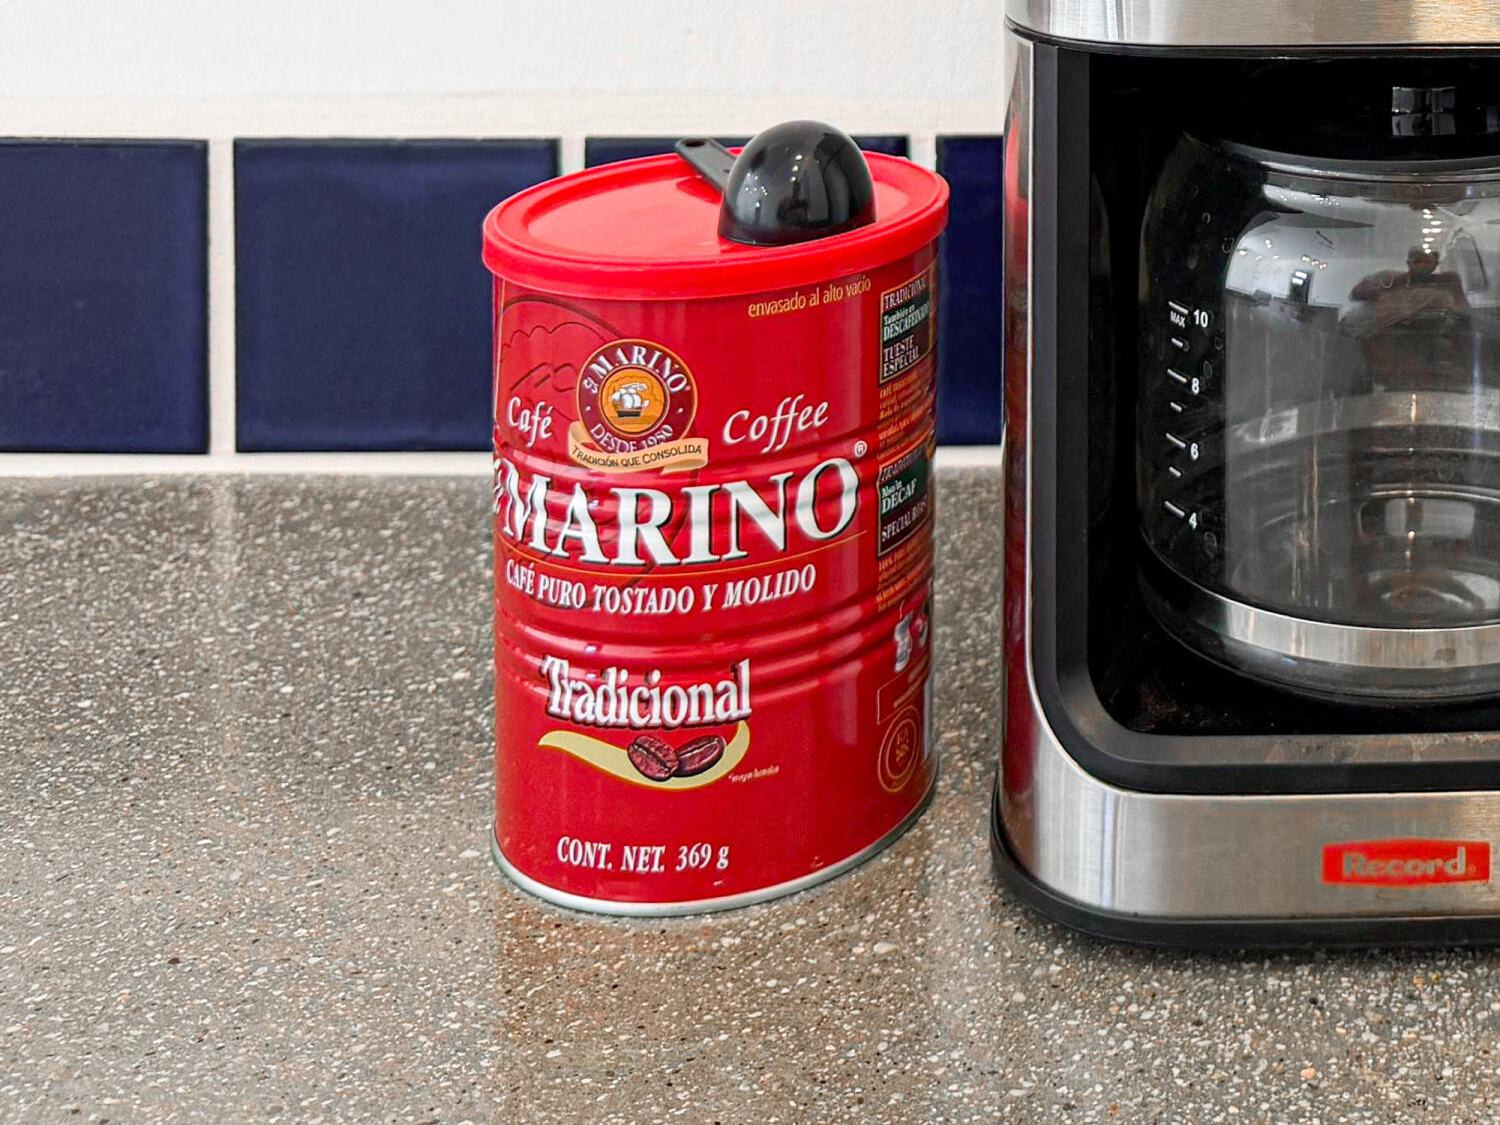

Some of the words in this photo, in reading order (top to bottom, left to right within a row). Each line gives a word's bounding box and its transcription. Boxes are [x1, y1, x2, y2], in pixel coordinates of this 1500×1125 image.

[748, 291, 806, 317] envasado
[809, 286, 820, 307] al
[823, 284, 844, 304] alto
[1170, 310, 1186, 328] MAX
[1193, 308, 1209, 328] 10
[883, 335, 914, 362] TUESTE
[883, 345, 919, 377] ESPECIAL
[590, 345, 688, 393] MARINO
[1191, 377, 1200, 395] 8
[508, 396, 554, 447] Café
[723, 394, 829, 454] Coffee
[590, 423, 637, 453] DESDE
[1190, 443, 1199, 460] 6
[621, 456, 641, 467] QUE
[642, 444, 702, 464] CONSOLIDA
[503, 457, 861, 565] MARINO
[882, 478, 917, 514] DECAF
[1188, 512, 1198, 530] 4
[506, 559, 535, 595] CAFÉ
[538, 575, 586, 609] PURO
[592, 584, 695, 615] TOSTADO
[702, 583, 720, 612] Y
[722, 564, 817, 609] MOLIDO
[541, 654, 753, 728] Tradicional
[557, 836, 613, 870] CONT.
[620, 845, 666, 873] NET.
[675, 842, 712, 872] 369
[716, 845, 730, 870] g
[1343, 845, 1467, 877] Record
